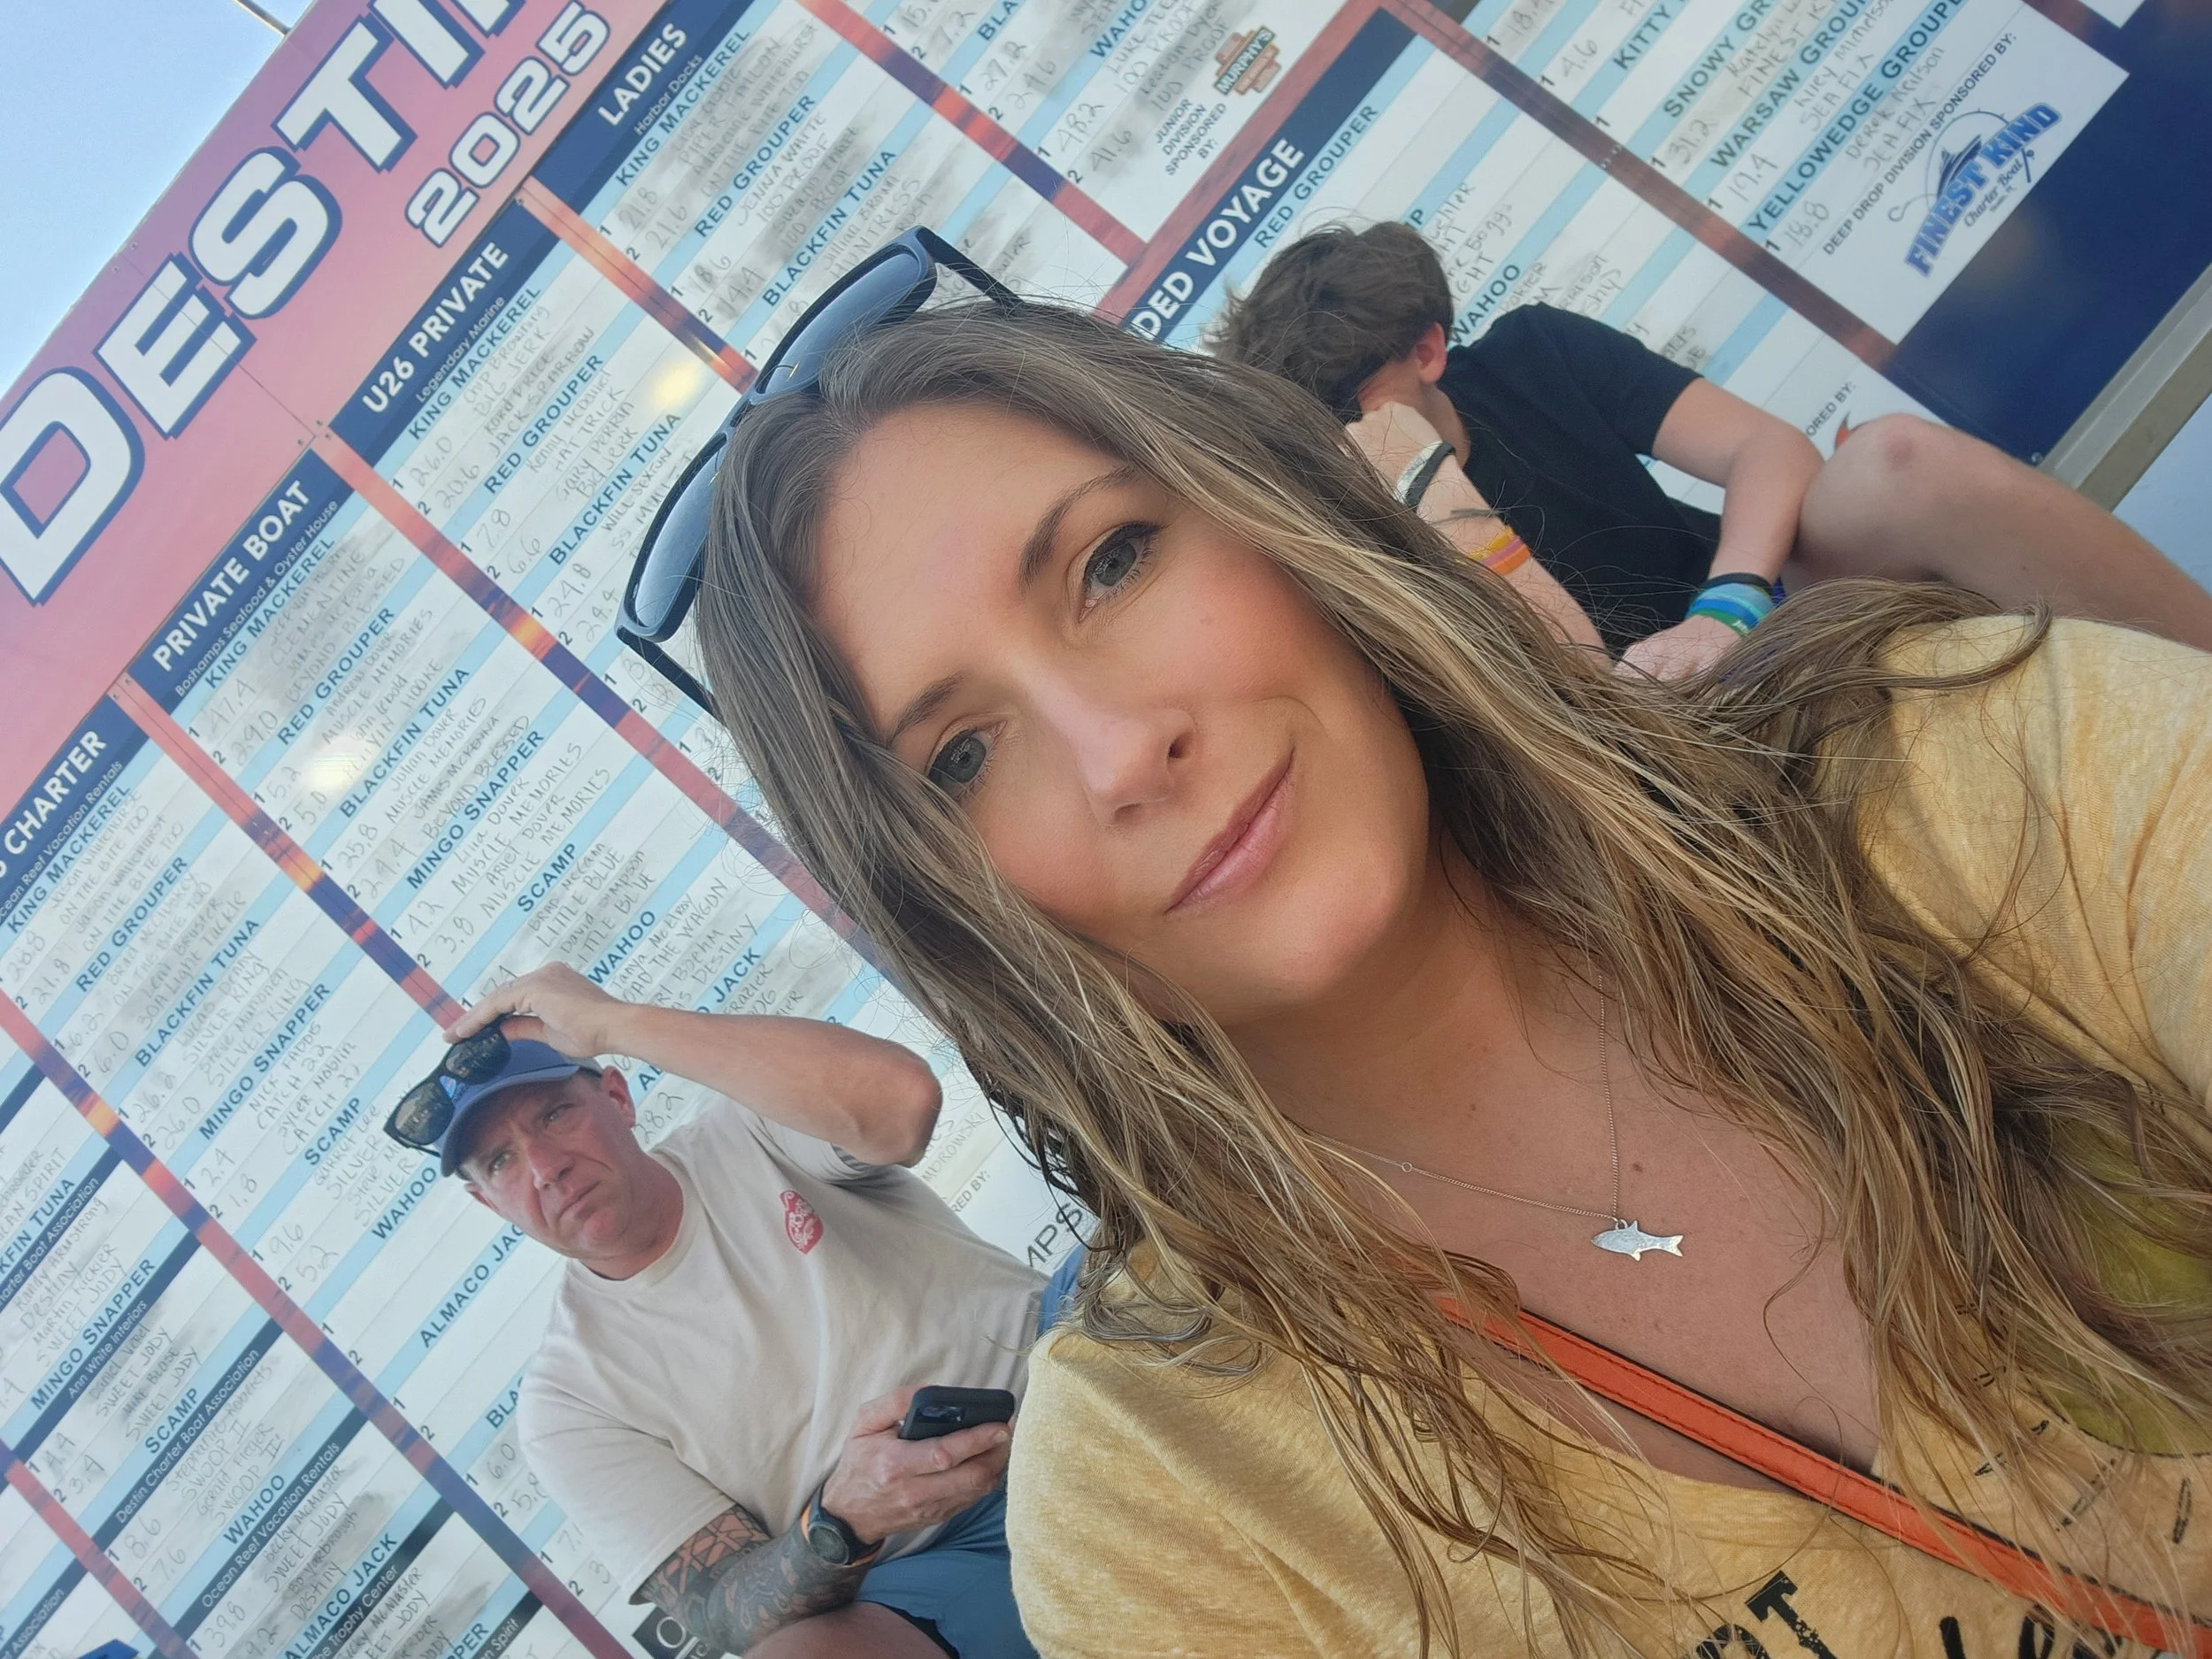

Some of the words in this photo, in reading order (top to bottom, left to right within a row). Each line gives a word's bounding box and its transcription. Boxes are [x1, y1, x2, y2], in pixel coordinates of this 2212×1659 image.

[597, 21, 688, 126] LADIES
[633, 91, 672, 134] Harbor
[667, 53, 703, 93] Docks
[1215, 27, 1274, 94] MURPHY'S
[1613, 3, 1673, 69] KITTY
[1662, 34, 1738, 119] SNOWY
[404, 0, 611, 248] 2025
[615, 134, 660, 186] KING
[658, 25, 750, 134] MACKEREL
[1151, 96, 1193, 144] JUNIOR
[1161, 103, 1207, 156] DIVISION
[1164, 101, 1228, 176] SPONSORED
[1196, 135, 1219, 159] BY:
[1710, 66, 1803, 171] WARSAW
[1748, 81, 1884, 234] YELLOWEDGE
[1822, 218, 1859, 257] DEEP
[1851, 181, 1890, 222] DROP
[1882, 127, 1935, 185] DIVISION
[1927, 51, 1999, 131] SPONSORED
[1990, 28, 2017, 55] BY:
[694, 193, 733, 237] RED
[732, 93, 816, 191] GROUPER
[1187, 138, 1305, 272] VOYAGE
[1254, 203, 1296, 249] RED
[1291, 103, 1379, 203] GROUPER
[1893, 158, 2005, 275] FINEST
[1977, 92, 2062, 177] KIND
[1961, 183, 2003, 228] Charter
[762, 205, 848, 306] BLACKFIN
[843, 146, 896, 206] TUNA
[0, 0, 527, 607] DESTI
[362, 352, 417, 413] U26
[408, 241, 508, 357] PRIVATE
[408, 388, 453, 440] KING
[450, 281, 541, 388] MACKEREL
[414, 336, 472, 403] Legendary
[466, 294, 507, 340] Marine
[483, 449, 523, 495] RED
[520, 352, 603, 449] GROUPER
[1833, 380, 1856, 403] BY:
[549, 466, 634, 565] BLACKFIN
[630, 409, 680, 466] TUNA
[152, 556, 250, 671] PRIVATE
[242, 480, 312, 560] BOAT
[173, 634, 227, 697] Boshamps
[221, 585, 268, 639] Seafood
[263, 573, 277, 588] &
[272, 534, 309, 578] Oyster
[303, 497, 340, 539] House
[204, 637, 249, 688] KING
[246, 533, 334, 638] MACKEREL
[277, 701, 315, 745] RED
[313, 605, 394, 701] GROUPER
[0, 729, 107, 856] CHARTER
[339, 719, 422, 818] BLACKFIN
[419, 664, 469, 721] TUNA
[5, 882, 48, 933] KING
[45, 780, 132, 884] MACKEREL
[19, 855, 46, 886] Reef
[42, 802, 90, 858] Vacation
[85, 759, 125, 806] Rentals
[406, 820, 466, 890] MINGO
[462, 726, 543, 822] SNAPPER
[75, 948, 112, 992] RED
[110, 856, 188, 949] GROUPER
[516, 840, 579, 913] SCAMP
[134, 971, 214, 1066] BLACKFIN
[211, 916, 259, 972] TUNA
[588, 906, 657, 987] WAHOO
[709, 945, 760, 1003] JACK
[199, 1072, 255, 1139] MINGO
[253, 981, 330, 1073] SNAPPER
[303, 1094, 364, 1166] SCAMP
[970, 1169, 990, 1191] BY:
[21, 1238, 50, 1271] Boat
[43, 1176, 101, 1244] Association
[30, 1175, 75, 1229] TUNA
[372, 1164, 437, 1241] WAHOO
[30, 1344, 85, 1409] MINGO
[82, 1257, 157, 1347] SNAPPER
[65, 1371, 88, 1398] Ann
[84, 1340, 114, 1375] White
[110, 1299, 148, 1344] Interiors
[418, 1261, 491, 1348] ALMACO
[114, 1481, 150, 1524] Destin
[143, 1440, 184, 1487] Charter
[178, 1411, 207, 1445] Boat
[201, 1347, 260, 1417] Association
[143, 1386, 202, 1455] SCAMP
[200, 1563, 239, 1609] Ocean
[234, 1534, 263, 1568] Reef
[257, 1483, 305, 1540] Vacation
[301, 1440, 341, 1487] Rentals
[223, 1471, 287, 1547] WAHOO
[349, 1531, 397, 1587] JACK
[9, 1585, 65, 1654] Association
[328, 1603, 366, 1648] Trophy
[360, 1563, 400, 1610] Center
[489, 1616, 519, 1651] Spirit
